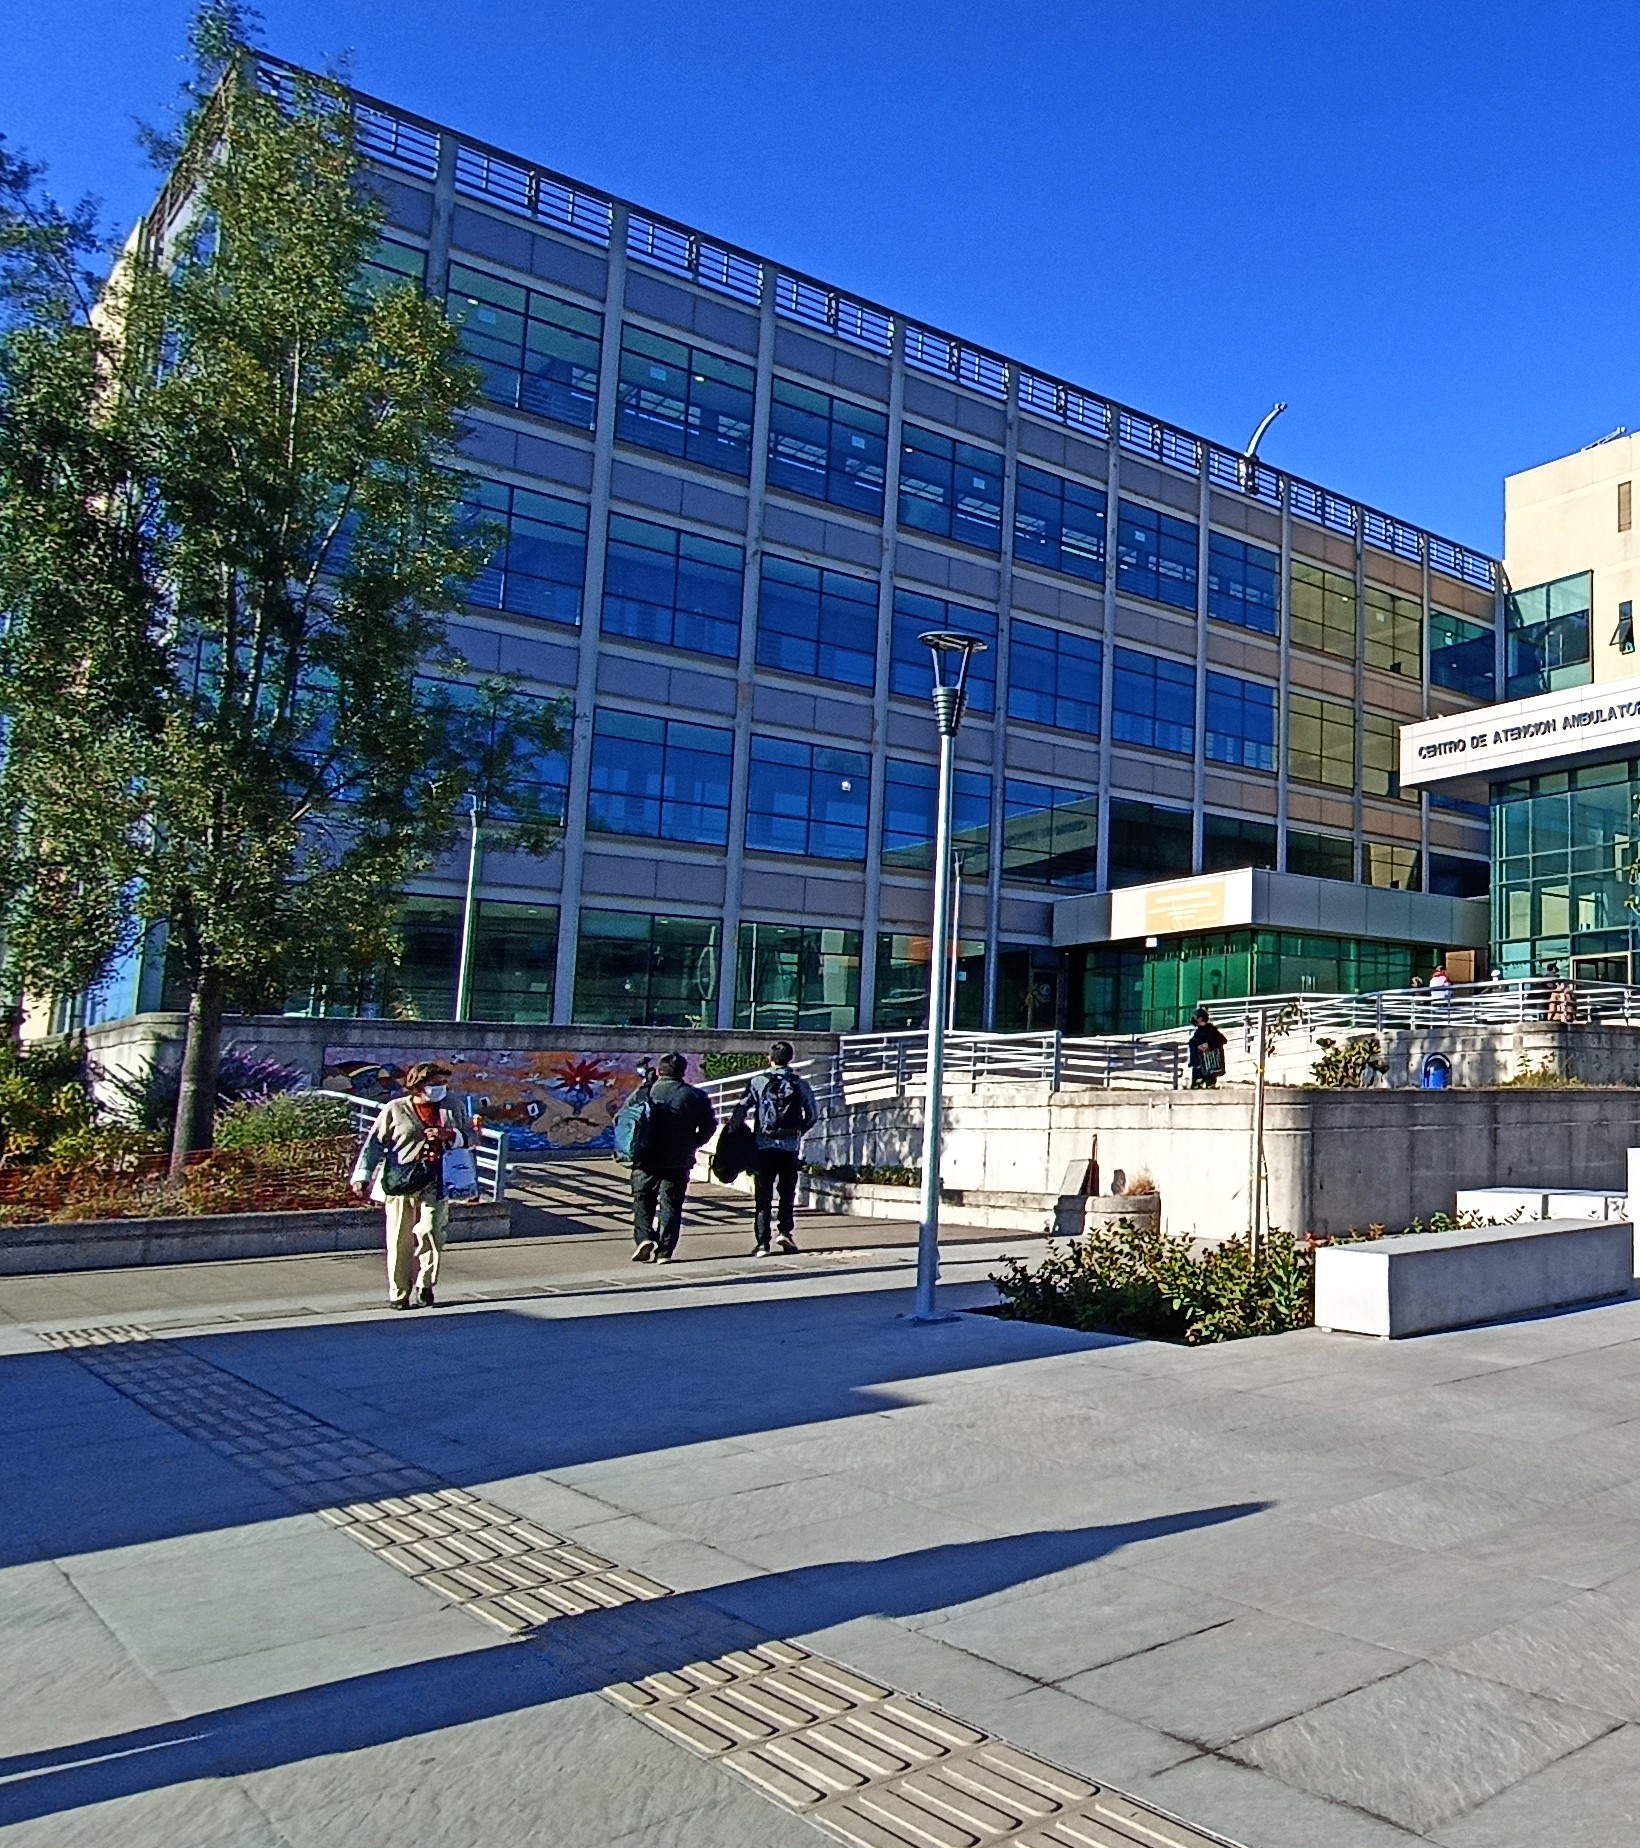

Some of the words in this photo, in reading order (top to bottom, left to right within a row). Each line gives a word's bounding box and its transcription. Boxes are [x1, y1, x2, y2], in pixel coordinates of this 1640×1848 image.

[1418, 738, 1467, 760] CENTRO
[1470, 733, 1488, 750] DE
[1492, 718, 1557, 745] ATENCION
